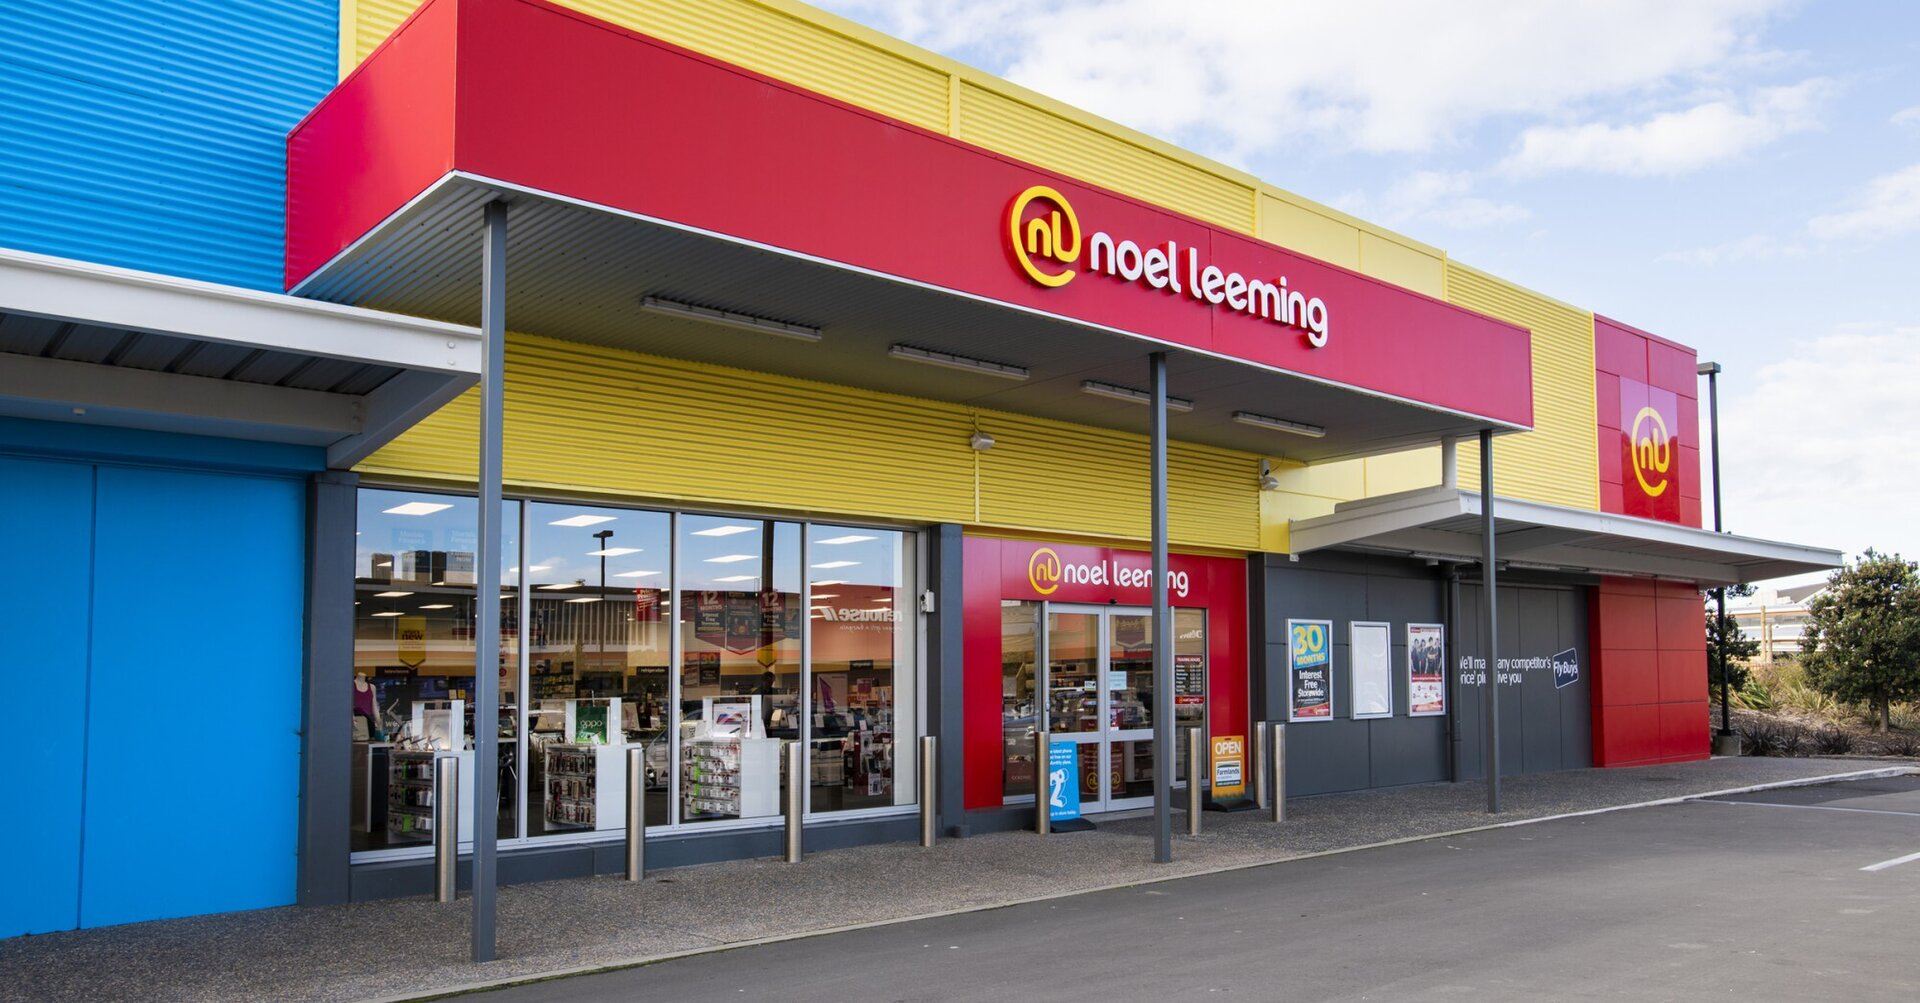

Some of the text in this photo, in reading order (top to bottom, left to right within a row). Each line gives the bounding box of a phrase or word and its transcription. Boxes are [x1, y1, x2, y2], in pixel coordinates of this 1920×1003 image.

[1090, 231, 1182, 294] noel
[1189, 247, 1329, 348] leeming
[1064, 560, 1109, 585] noel
[1113, 561, 1189, 598] leeng
[1293, 625, 1323, 655] 30
[1296, 653, 1326, 665] MONTHS
[1497, 658, 1510, 671] any
[1511, 656, 1551, 671] competitor's
[1299, 670, 1322, 680] Interest
[1497, 671, 1507, 684] ive
[1509, 672, 1522, 686] you
[1304, 680, 1318, 689] Free
[1298, 688, 1324, 698] Storewide
[1215, 740, 1242, 755] OPEN
